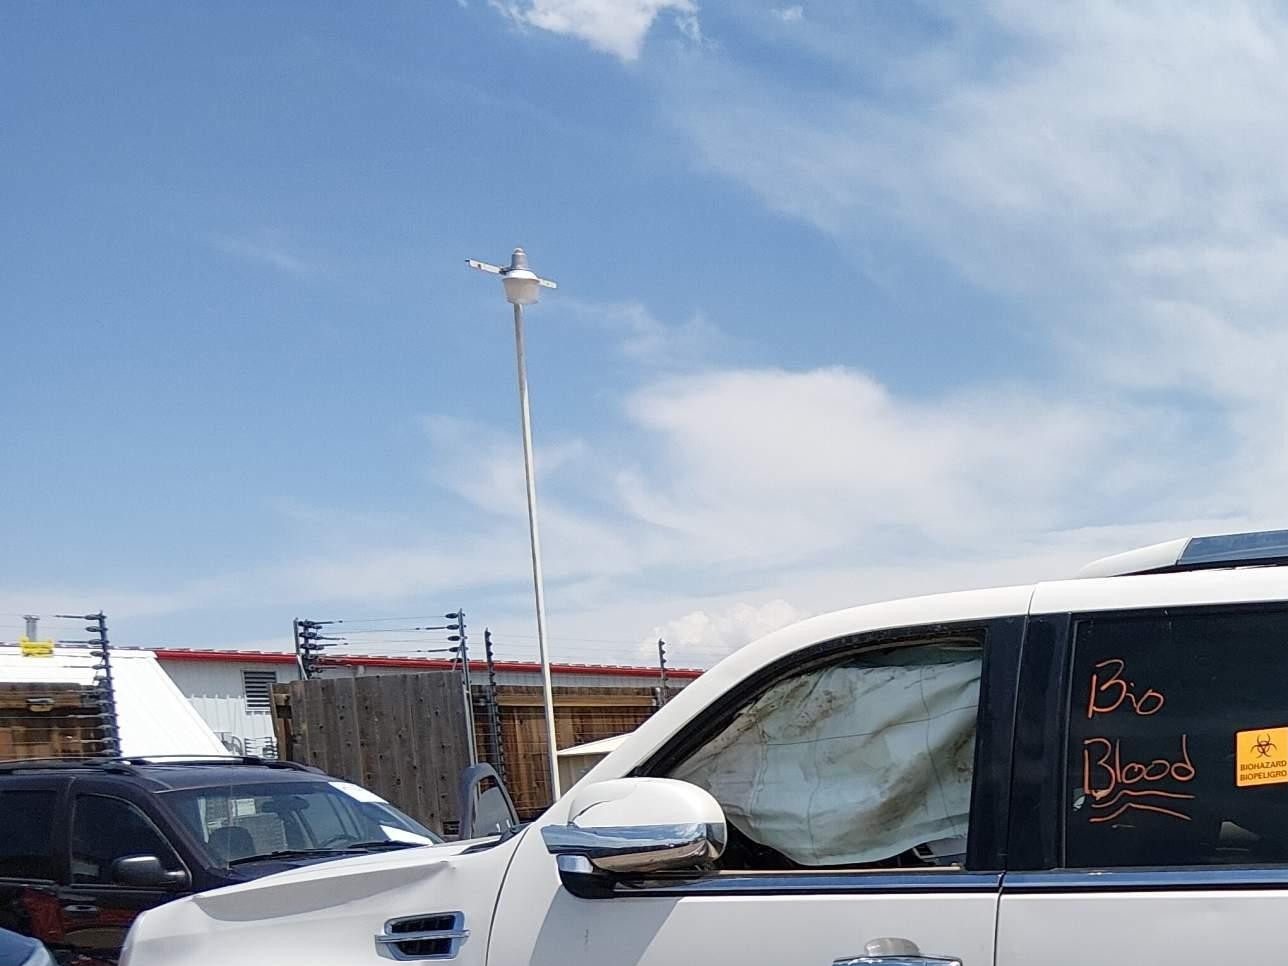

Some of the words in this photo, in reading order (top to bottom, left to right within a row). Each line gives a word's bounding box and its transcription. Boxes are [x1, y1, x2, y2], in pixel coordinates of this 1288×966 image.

[1088, 659, 1165, 719] Bio
[1084, 734, 1196, 801] Blood
[1240, 760, 1287, 771] BIOHAZARD
[1240, 770, 1288, 781] BIOPELIGRO
